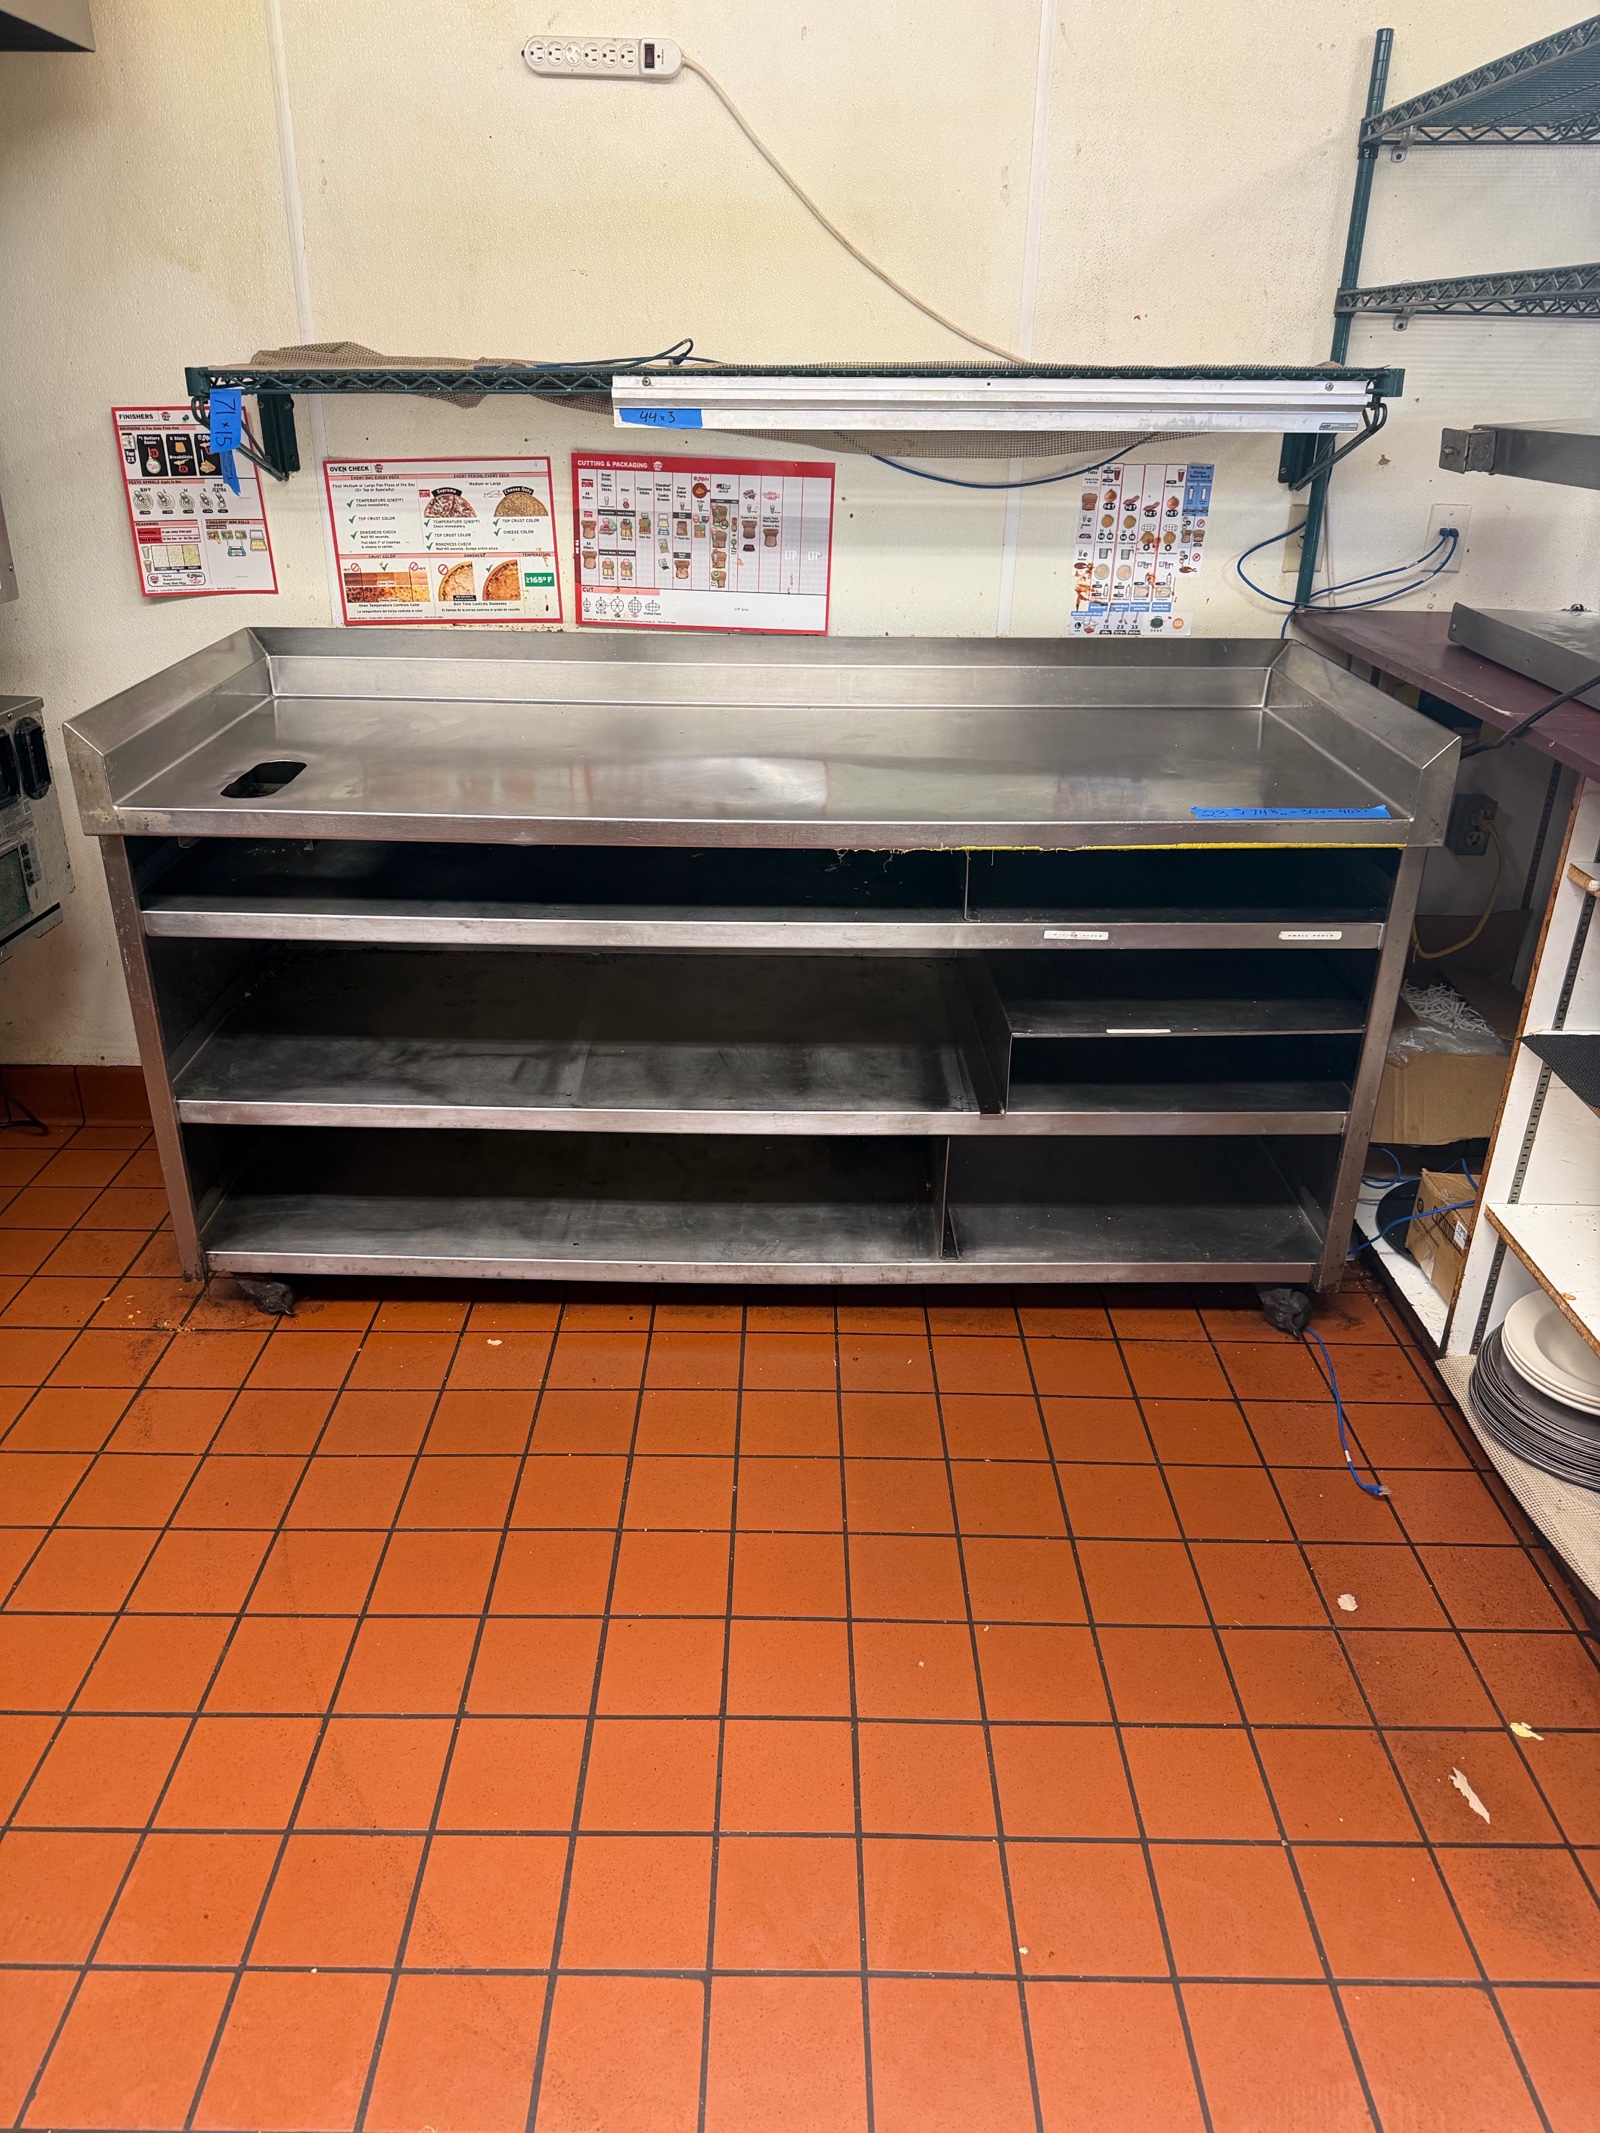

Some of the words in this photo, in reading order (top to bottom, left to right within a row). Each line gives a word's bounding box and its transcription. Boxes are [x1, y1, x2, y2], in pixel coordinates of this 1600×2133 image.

[612, 461, 648, 469] PACKAGING
[503, 487, 520, 495] Cheese
[785, 550, 797, 560] LTP
[808, 551, 820, 560] LTP
